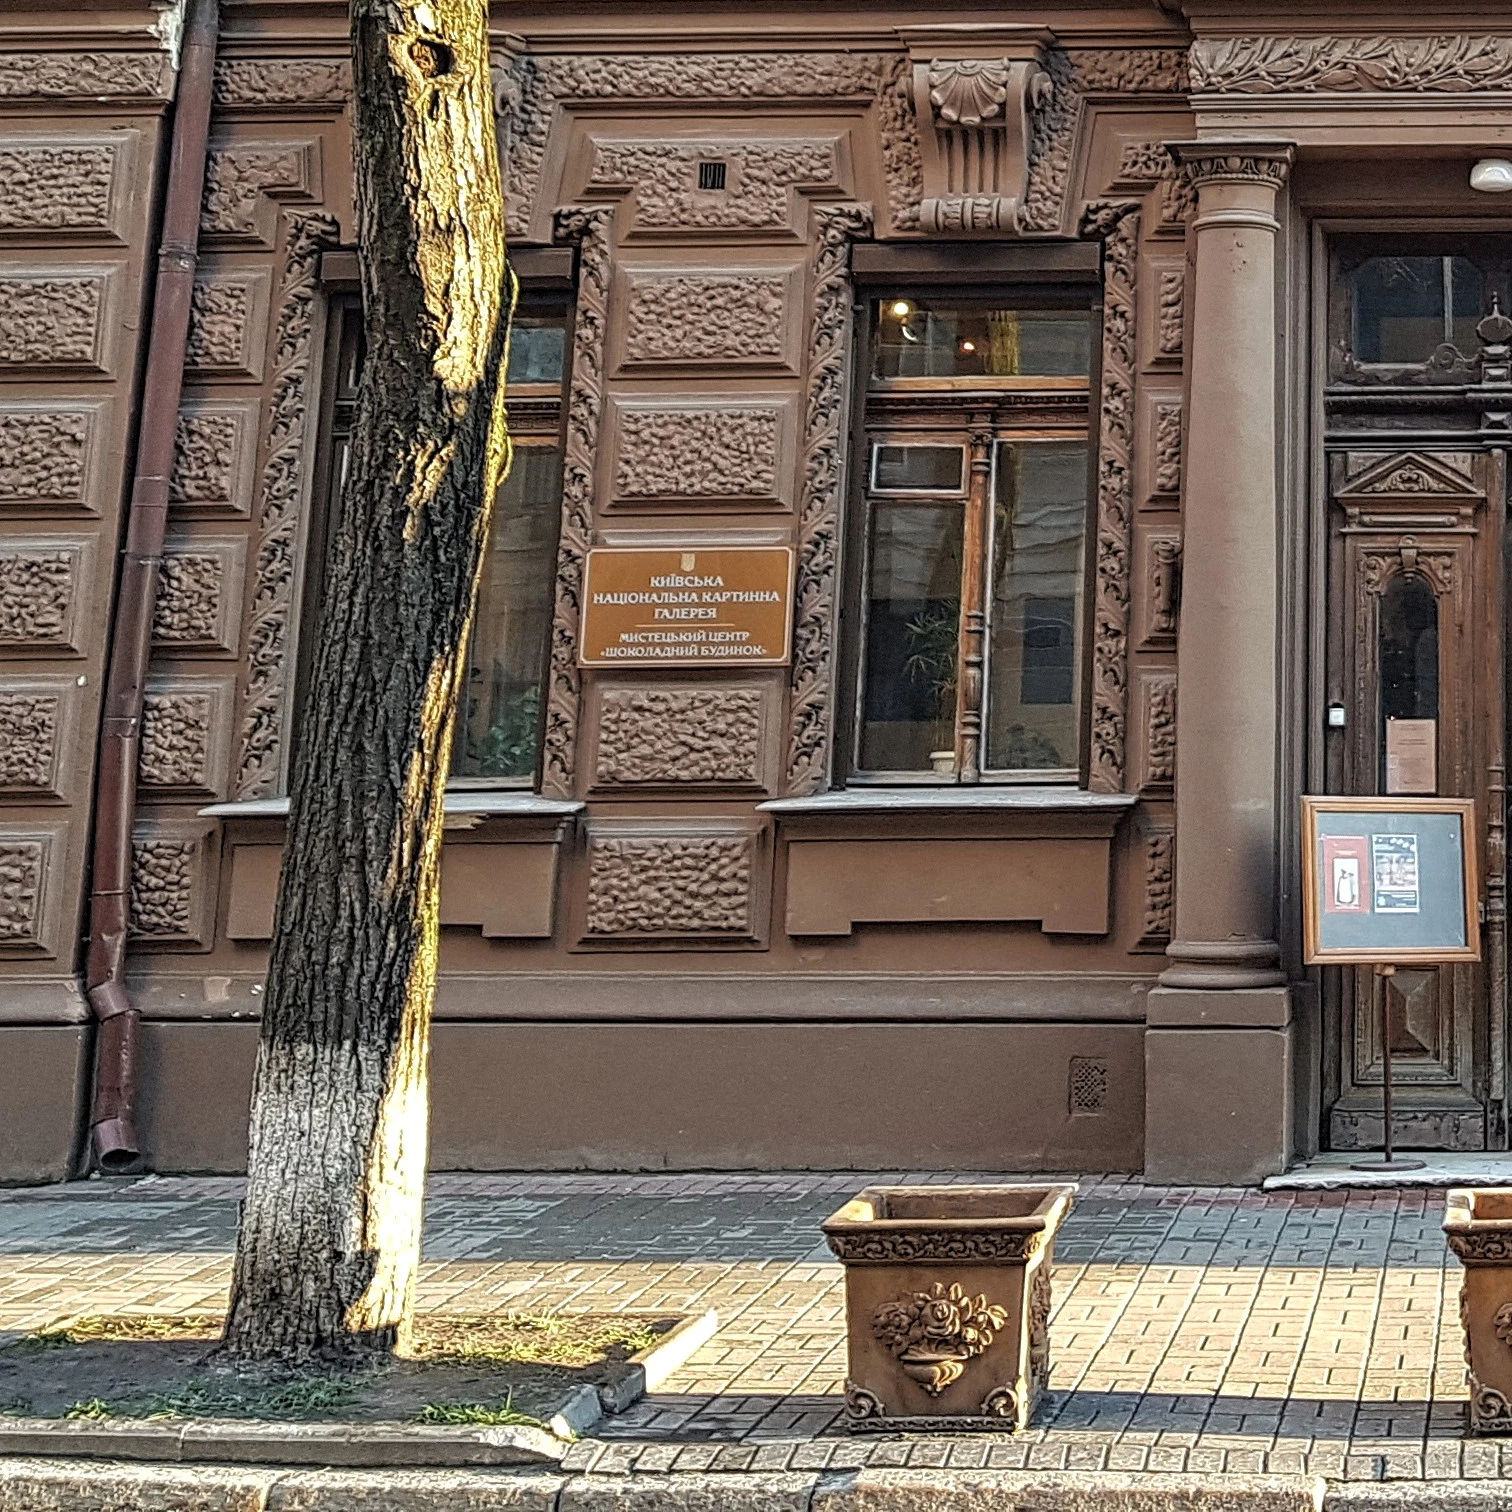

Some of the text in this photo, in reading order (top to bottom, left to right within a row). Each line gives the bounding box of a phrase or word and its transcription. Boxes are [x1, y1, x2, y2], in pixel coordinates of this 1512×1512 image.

[650, 574, 724, 587] КИЇВСЬКА
[593, 591, 780, 605] НАЦІОНАЛЬНА КАРТИННА
[654, 608, 717, 619] ГАЛЕРЕЯ
[619, 630, 750, 643] МИСТЕЦЬКИЙ ЦЕНТР
